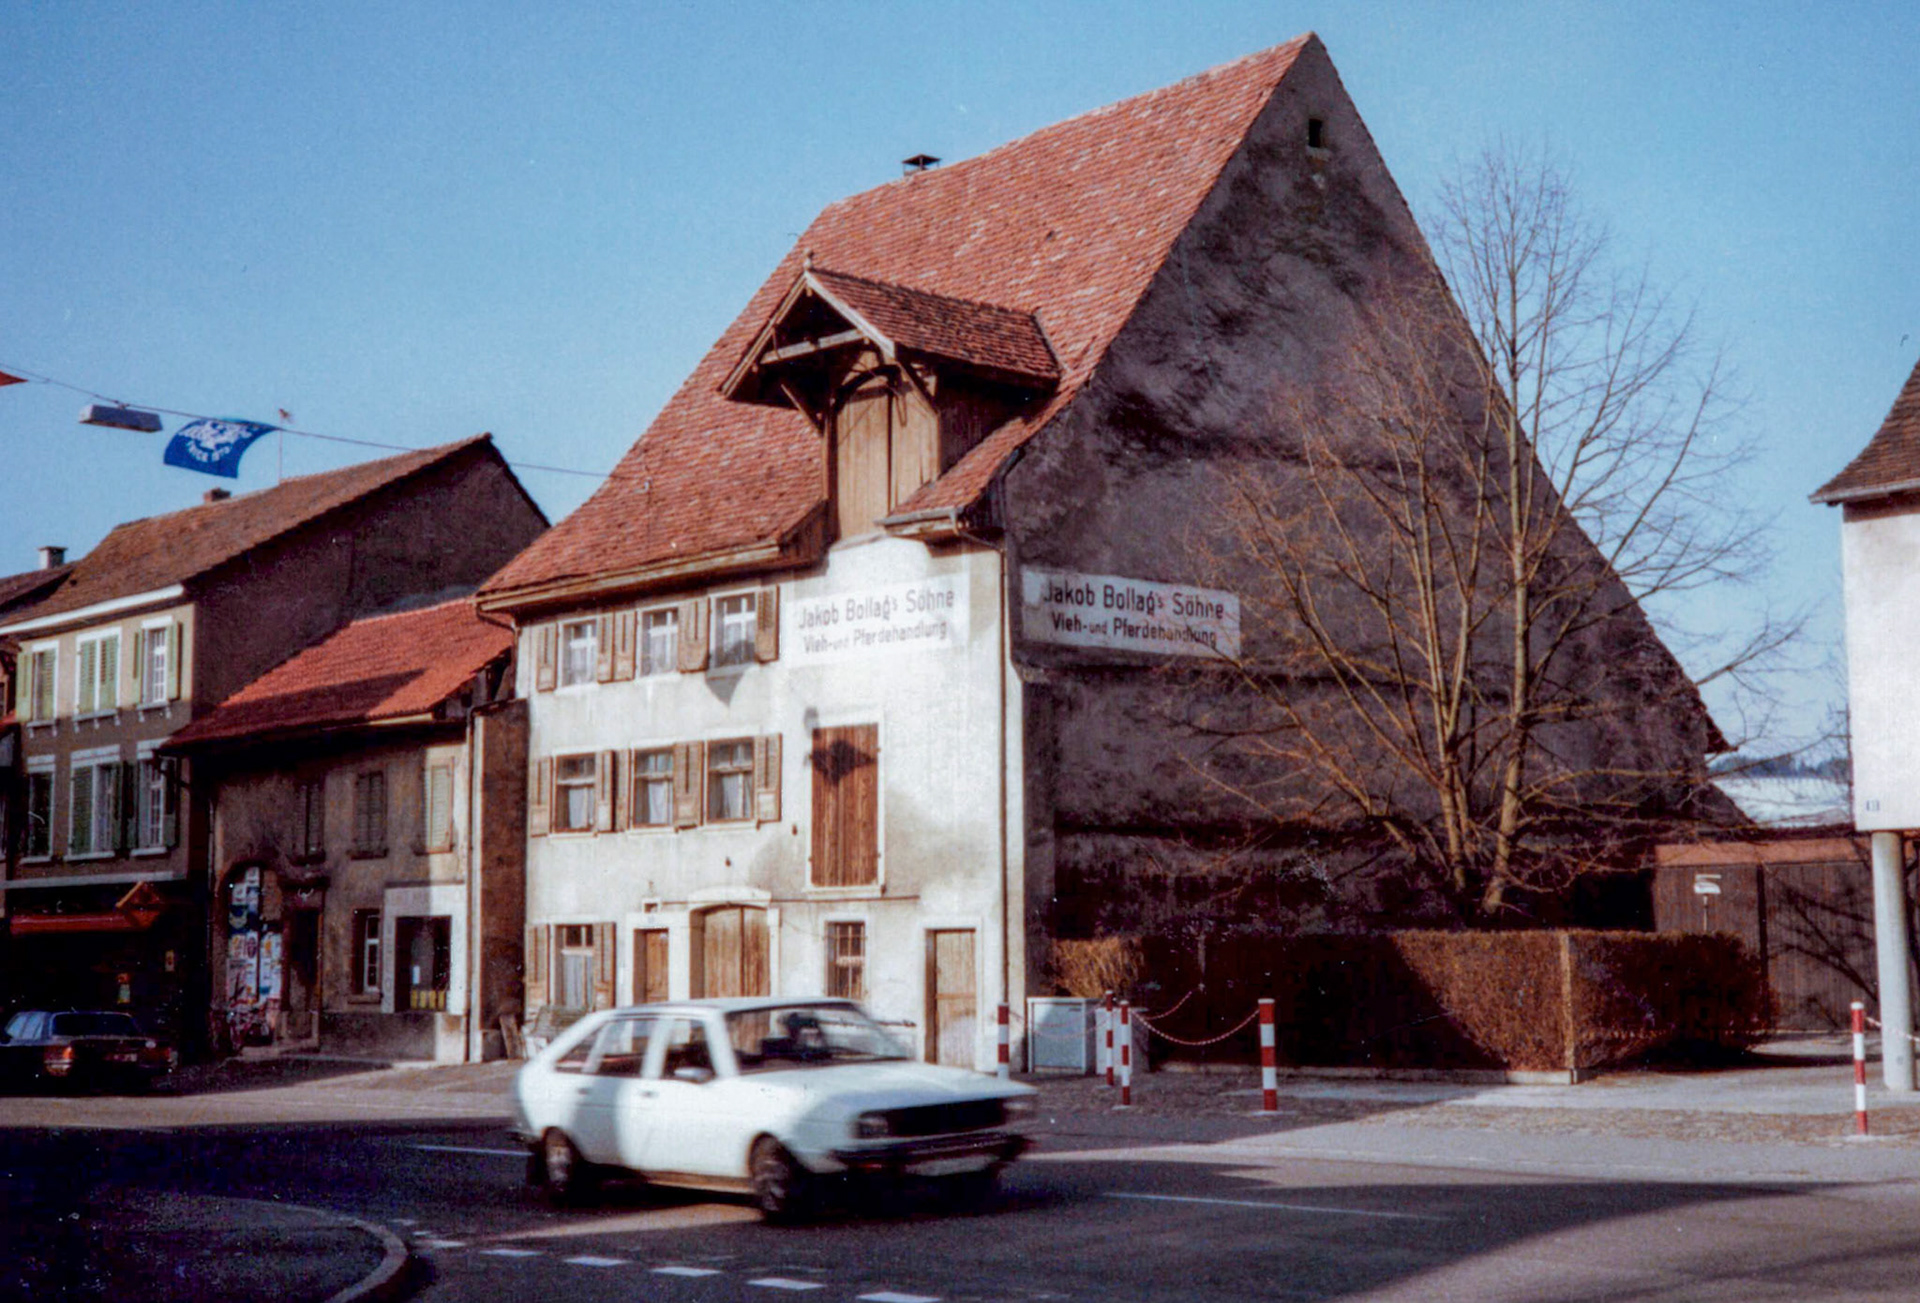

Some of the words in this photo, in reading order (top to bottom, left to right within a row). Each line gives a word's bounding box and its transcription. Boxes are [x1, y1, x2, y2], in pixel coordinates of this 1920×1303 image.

[799, 602, 840, 629] Jakob
[1042, 579, 1095, 607] Jakob
[1172, 592, 1225, 619] Söhne
